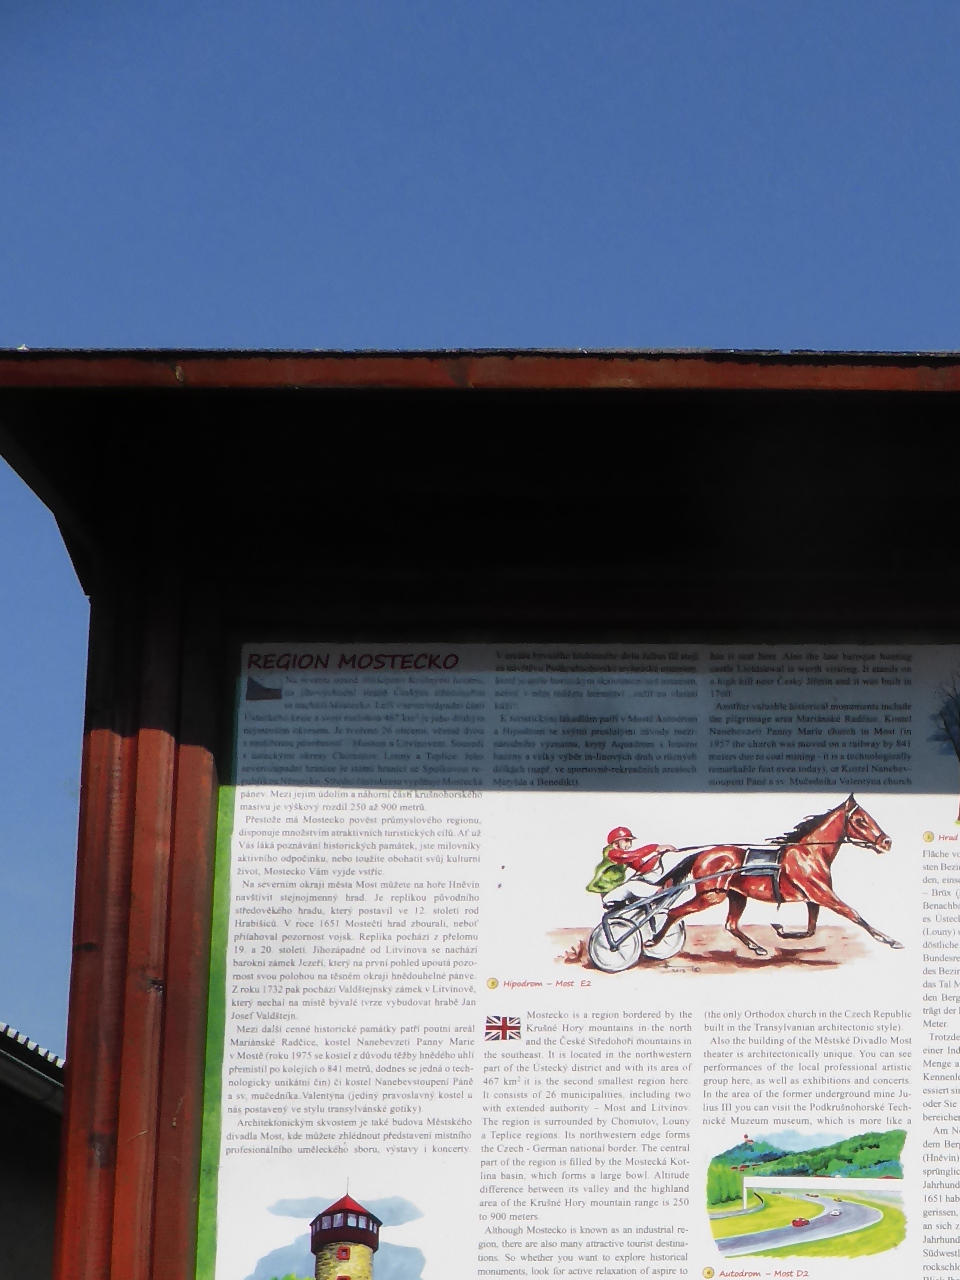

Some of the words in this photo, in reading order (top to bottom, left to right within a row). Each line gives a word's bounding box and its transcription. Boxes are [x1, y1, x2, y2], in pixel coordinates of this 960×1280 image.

[246, 652, 330, 671] REGION
[337, 652, 460, 670] MOSTECKO
[938, 833, 959, 841] Hrad
[503, 980, 543, 990] Hipodrom
[230, 1011, 255, 1020] Josef
[256, 1011, 298, 1022] Valdštejn.
[526, 1010, 569, 1019] Mostecko
[591, 1012, 620, 1021] region
[622, 1010, 661, 1019] bordered
[664, 1010, 675, 1020] by
[679, 1010, 693, 1019] the
[526, 1023, 558, 1032] Krušné
[562, 1024, 584, 1034] Hory
[638, 1024, 648, 1032] in
[651, 1023, 665, 1032] the
[669, 1023, 692, 1032] north
[718, 1269, 761, 1278] Autodrom
[774, 1270, 794, 1278] Most
[796, 1270, 809, 1278] D2
